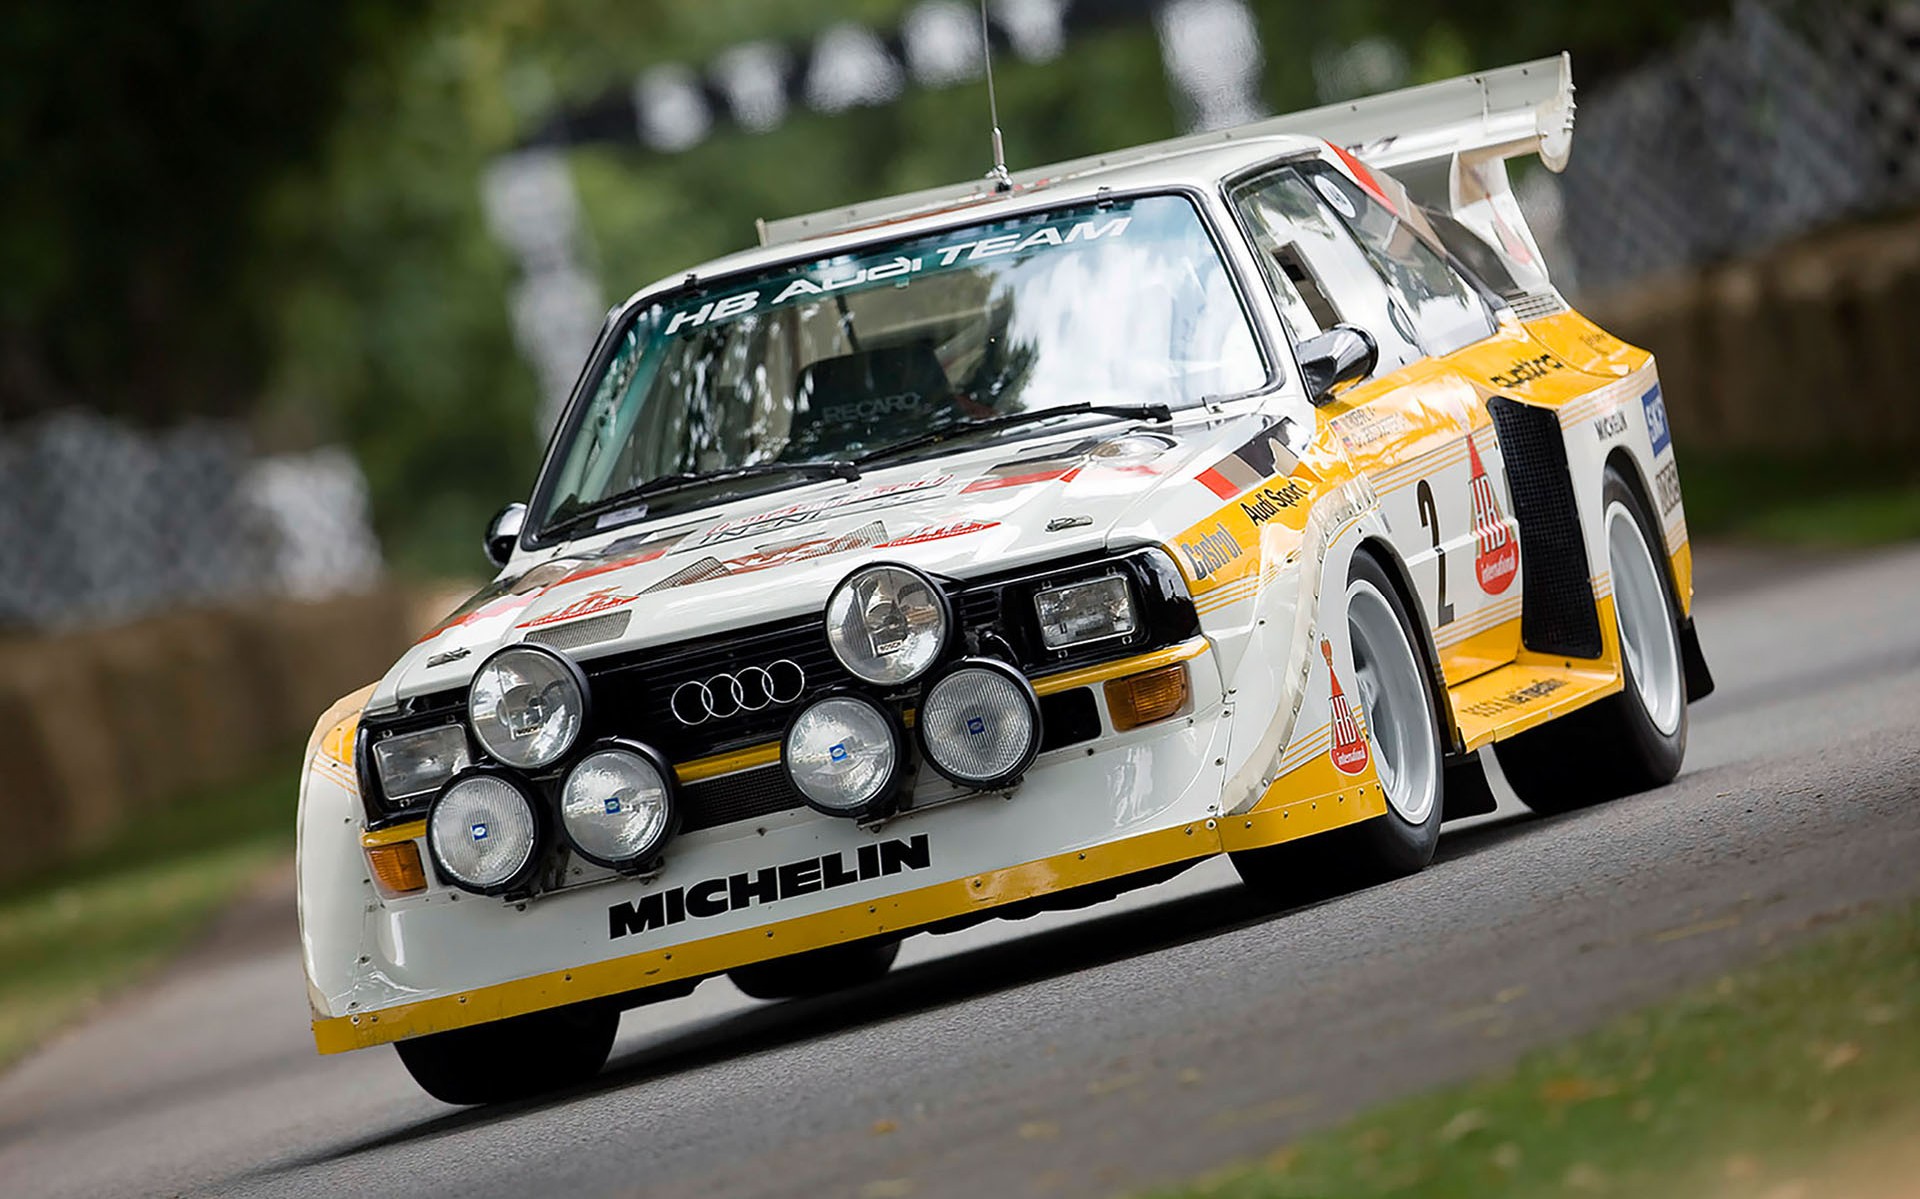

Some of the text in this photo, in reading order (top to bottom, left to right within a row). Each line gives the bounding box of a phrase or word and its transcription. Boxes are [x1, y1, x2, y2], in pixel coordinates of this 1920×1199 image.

[664, 290, 760, 336] HB
[937, 216, 1132, 267] TEAM
[824, 392, 920, 422] RECARO
[1240, 481, 1309, 527] Audi Sport
[1468, 474, 1506, 554] HB
[1181, 522, 1243, 581] Castrol
[1417, 479, 1455, 628] 2
[877, 640, 902, 655] BOSCH
[1328, 693, 1357, 747] HB
[608, 833, 931, 940] MICHELIN
